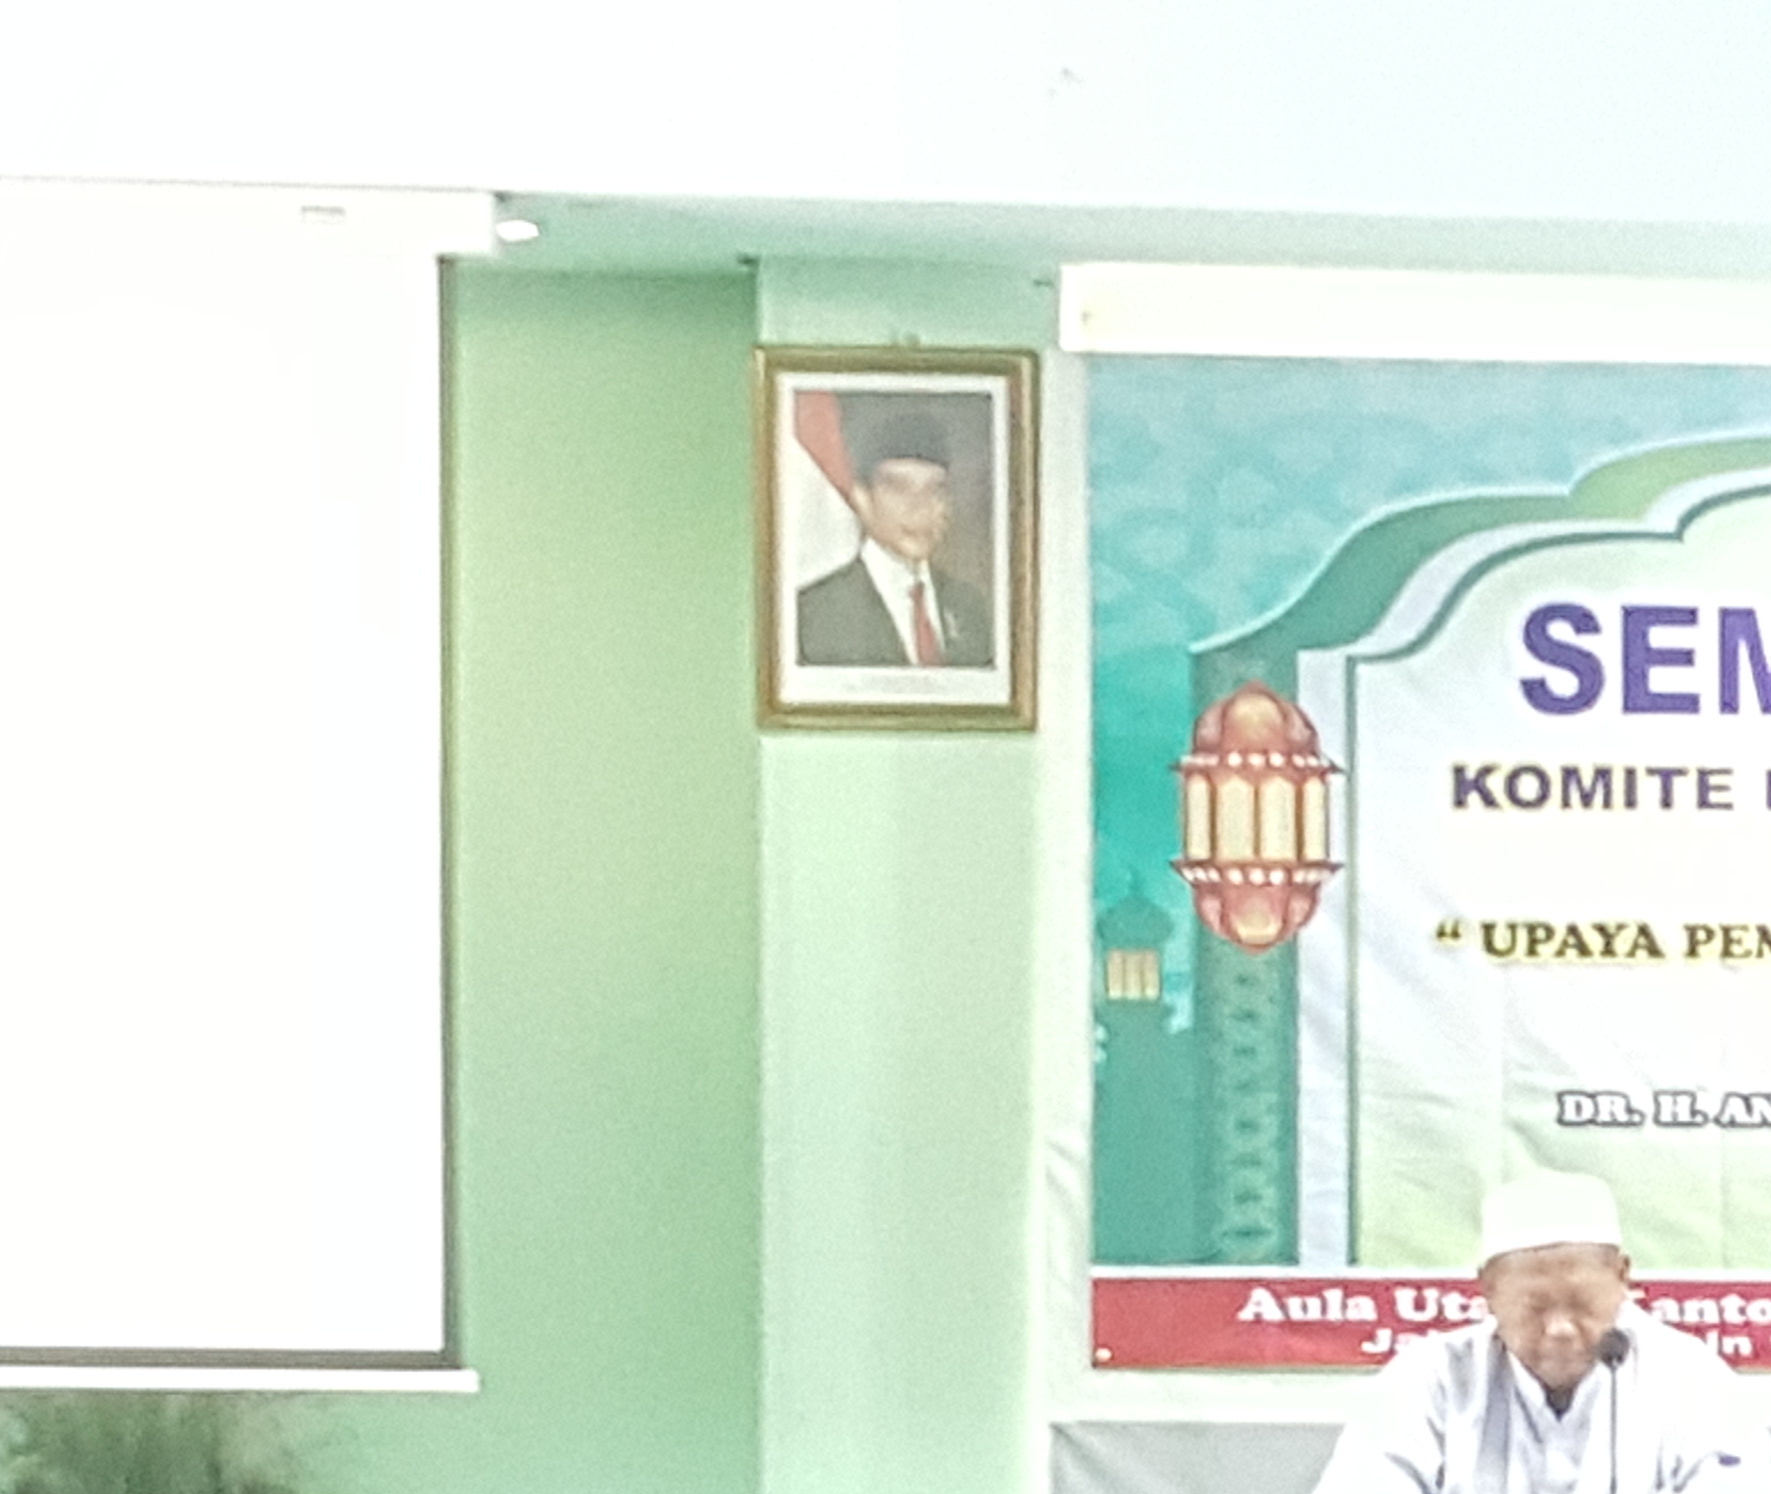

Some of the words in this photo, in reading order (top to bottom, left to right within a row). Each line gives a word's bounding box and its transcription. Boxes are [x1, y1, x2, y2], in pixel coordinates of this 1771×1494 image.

[1450, 763, 1735, 812] KOMITE
[1480, 920, 1667, 964] UPAYA
[1557, 1090, 1643, 1127] DR.
[1654, 1091, 1708, 1128] H.
[1237, 1287, 1379, 1322] Aula
[1393, 1287, 1489, 1322] Uta
